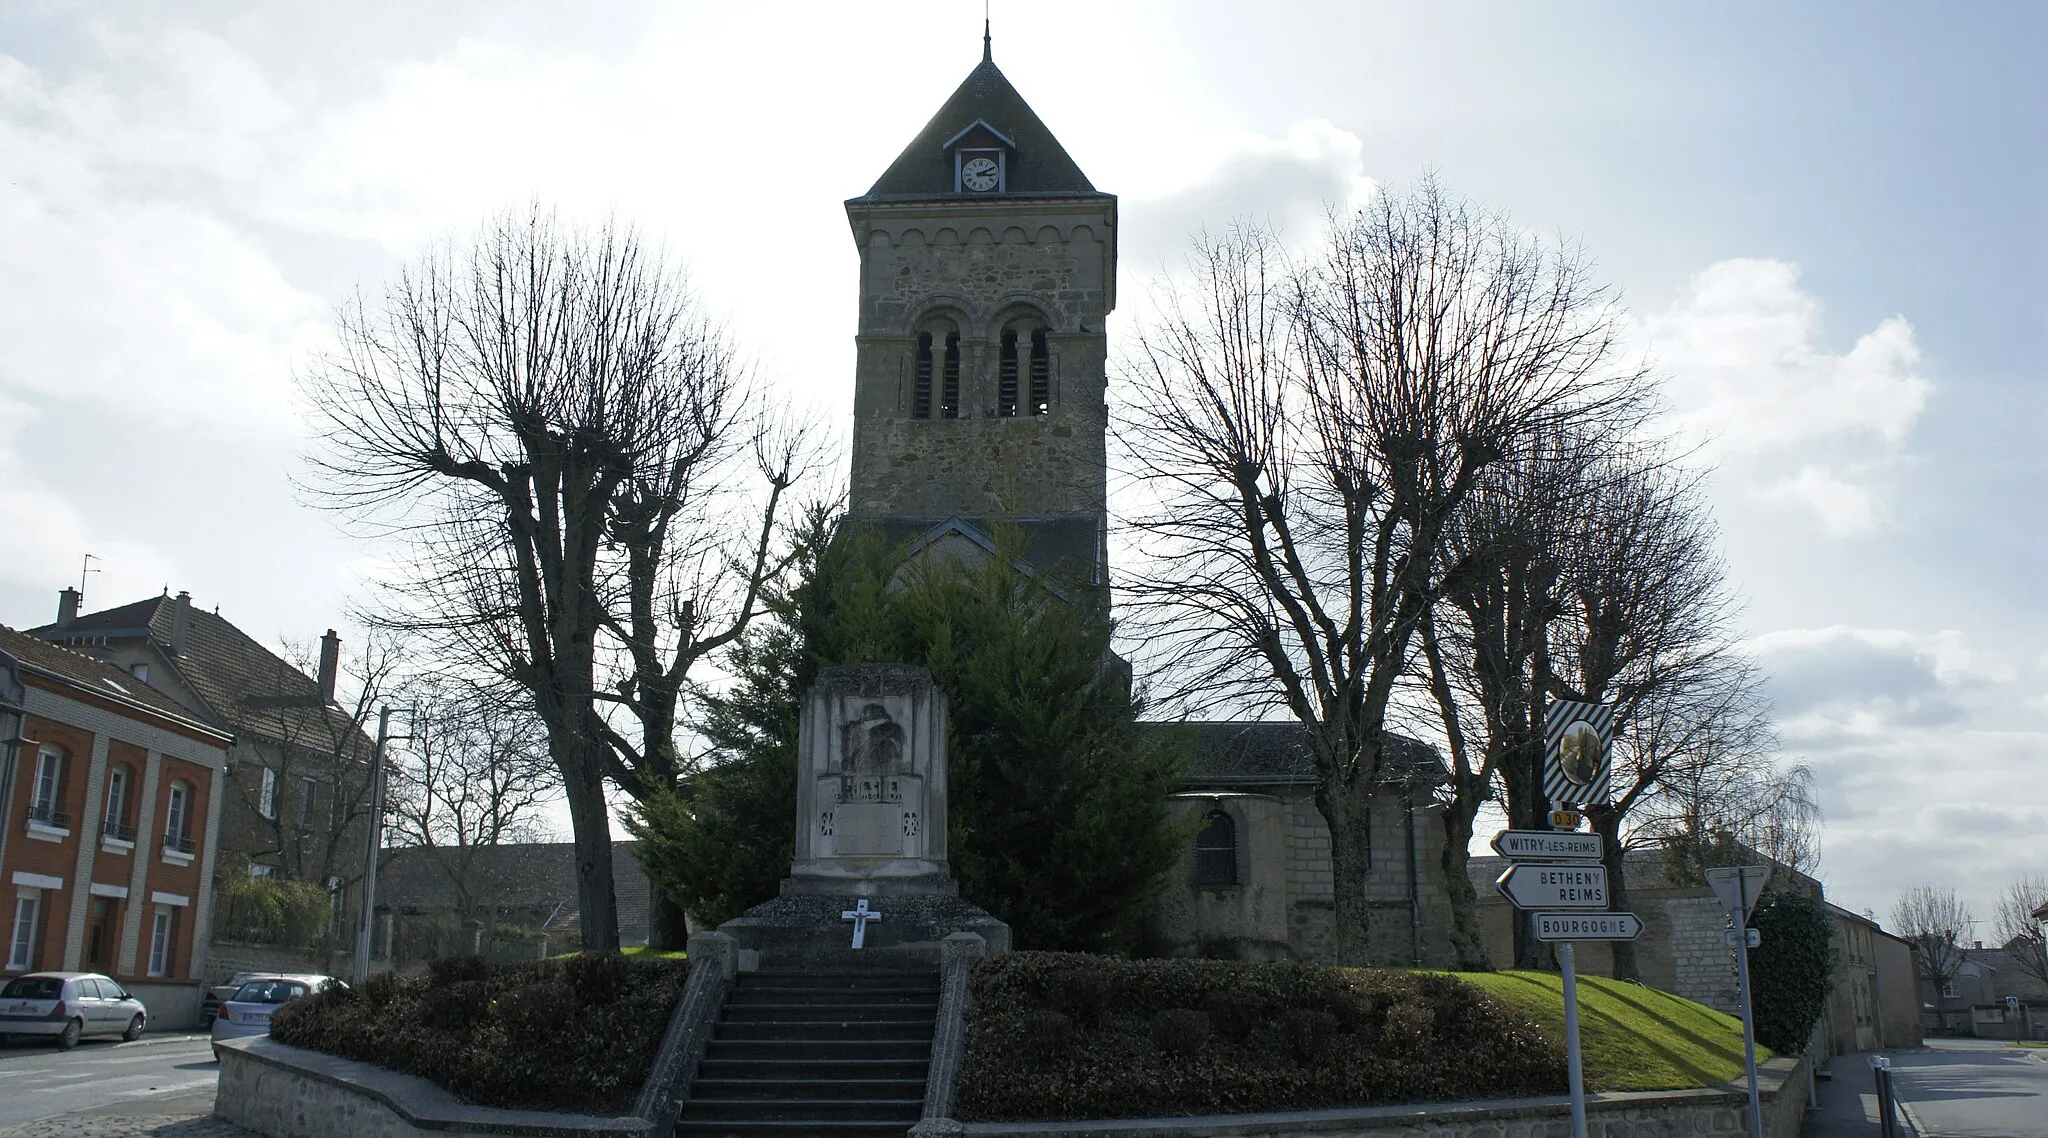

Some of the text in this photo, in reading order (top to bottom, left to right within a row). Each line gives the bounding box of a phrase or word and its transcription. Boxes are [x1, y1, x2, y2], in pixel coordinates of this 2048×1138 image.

[1554, 814, 1580, 826] D 30
[1509, 838, 1597, 853] WITRY-LES-REIMS
[1540, 872, 1600, 885] BETHENY
[1560, 888, 1602, 901] REIMS
[1543, 920, 1626, 934] BOURGOGNE
